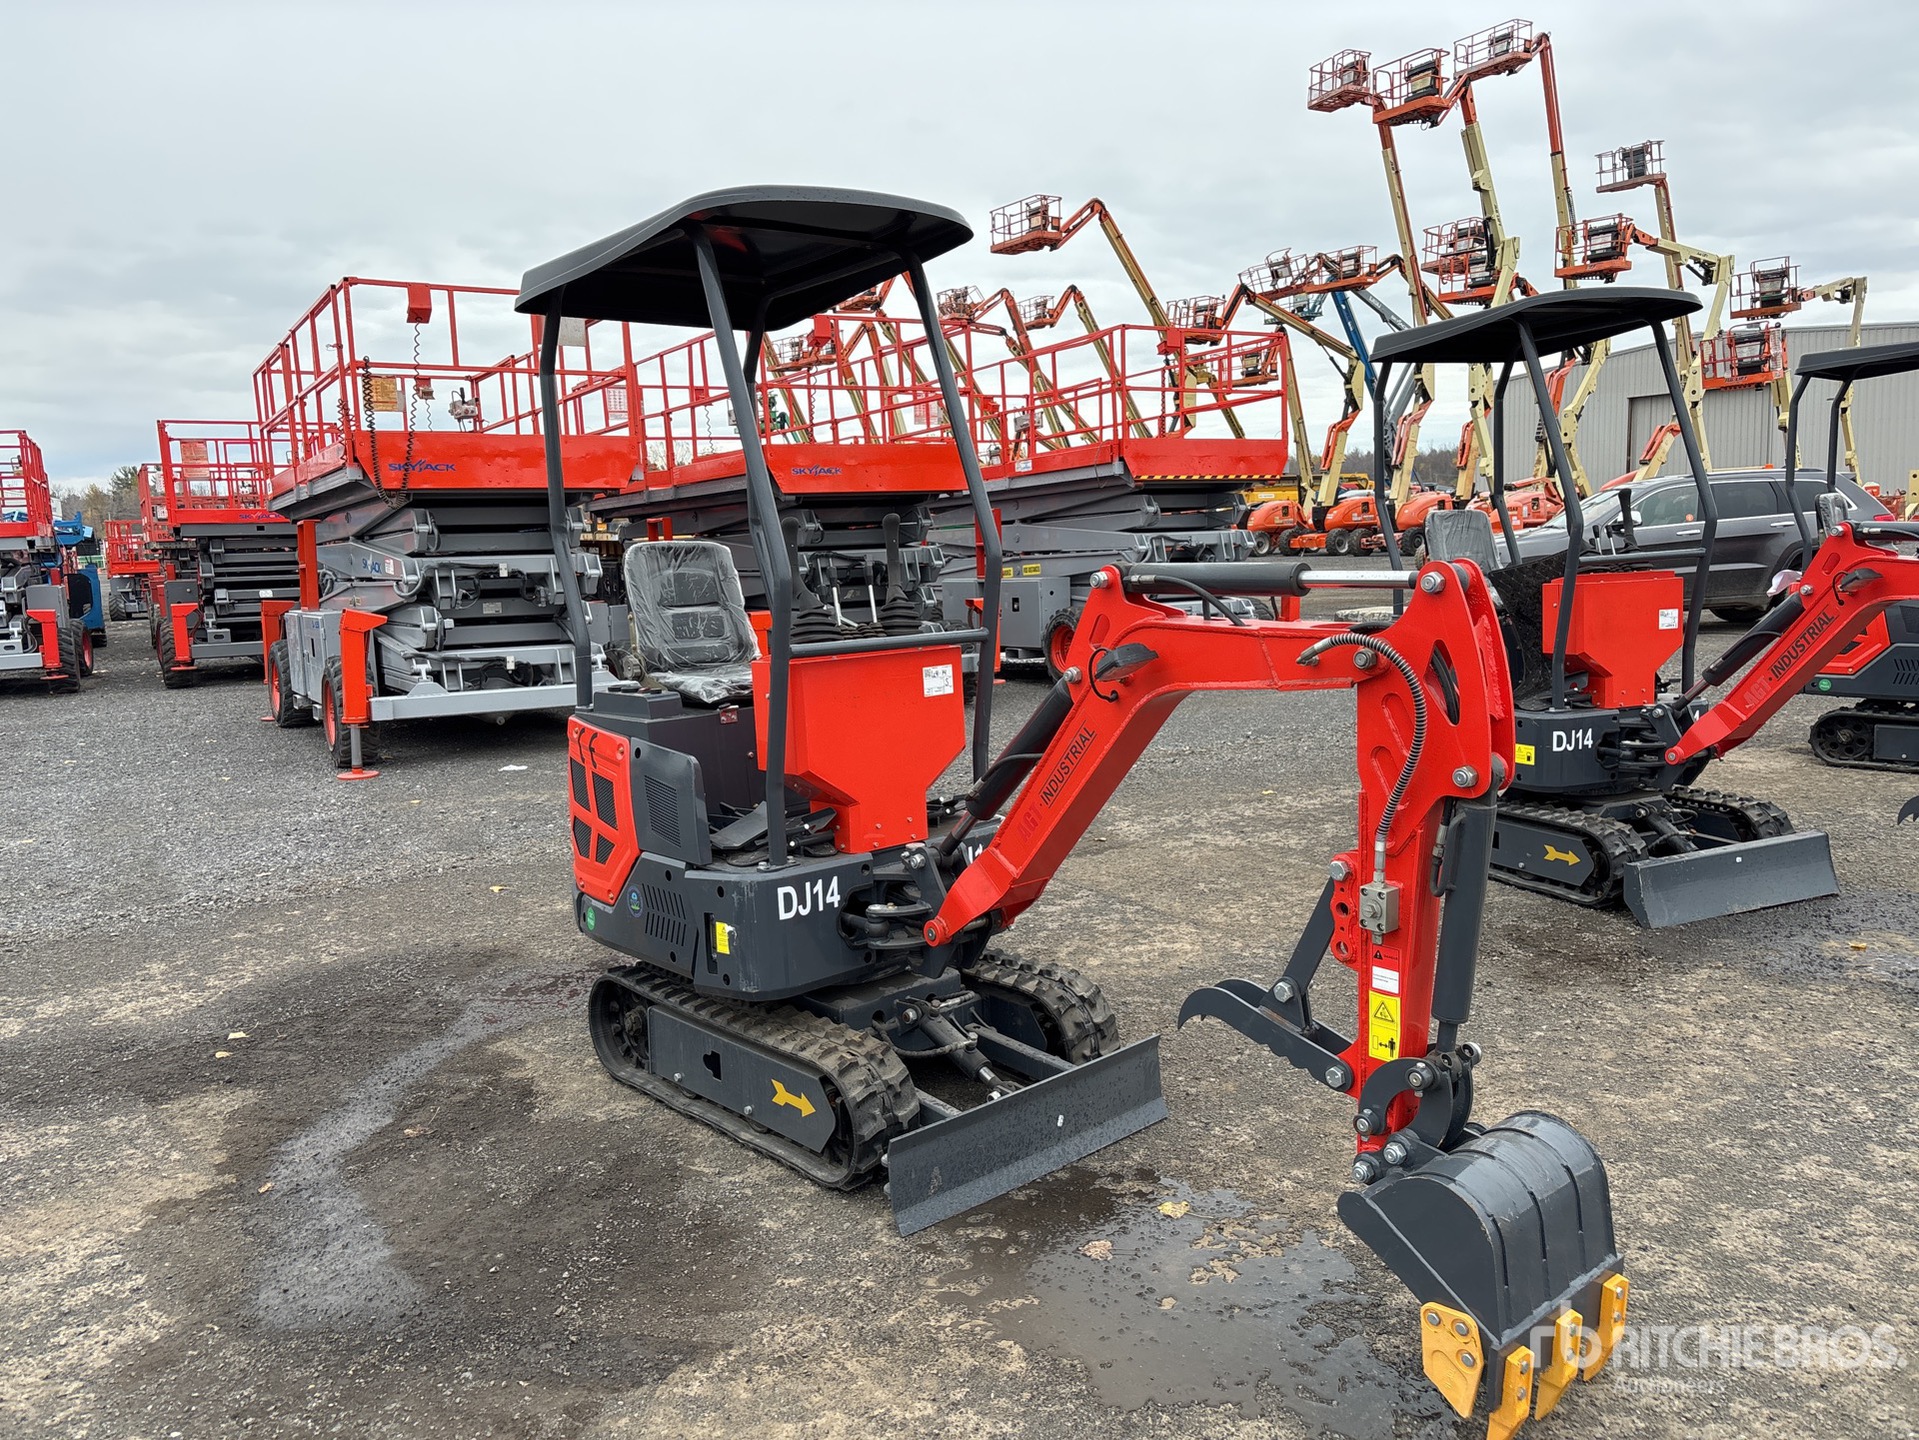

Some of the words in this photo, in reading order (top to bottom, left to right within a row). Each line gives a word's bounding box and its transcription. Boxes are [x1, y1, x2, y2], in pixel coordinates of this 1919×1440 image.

[388, 459, 457, 473] SKYJACK
[791, 464, 842, 476] SKYJACK
[1744, 676, 1772, 708] AGT
[1770, 611, 1835, 679] INDUSTRIAL
[1552, 728, 1594, 752] DJ14
[1017, 802, 1043, 841] AGT
[1040, 726, 1096, 806] INDUSTRIAL
[777, 876, 841, 920] DJ14
